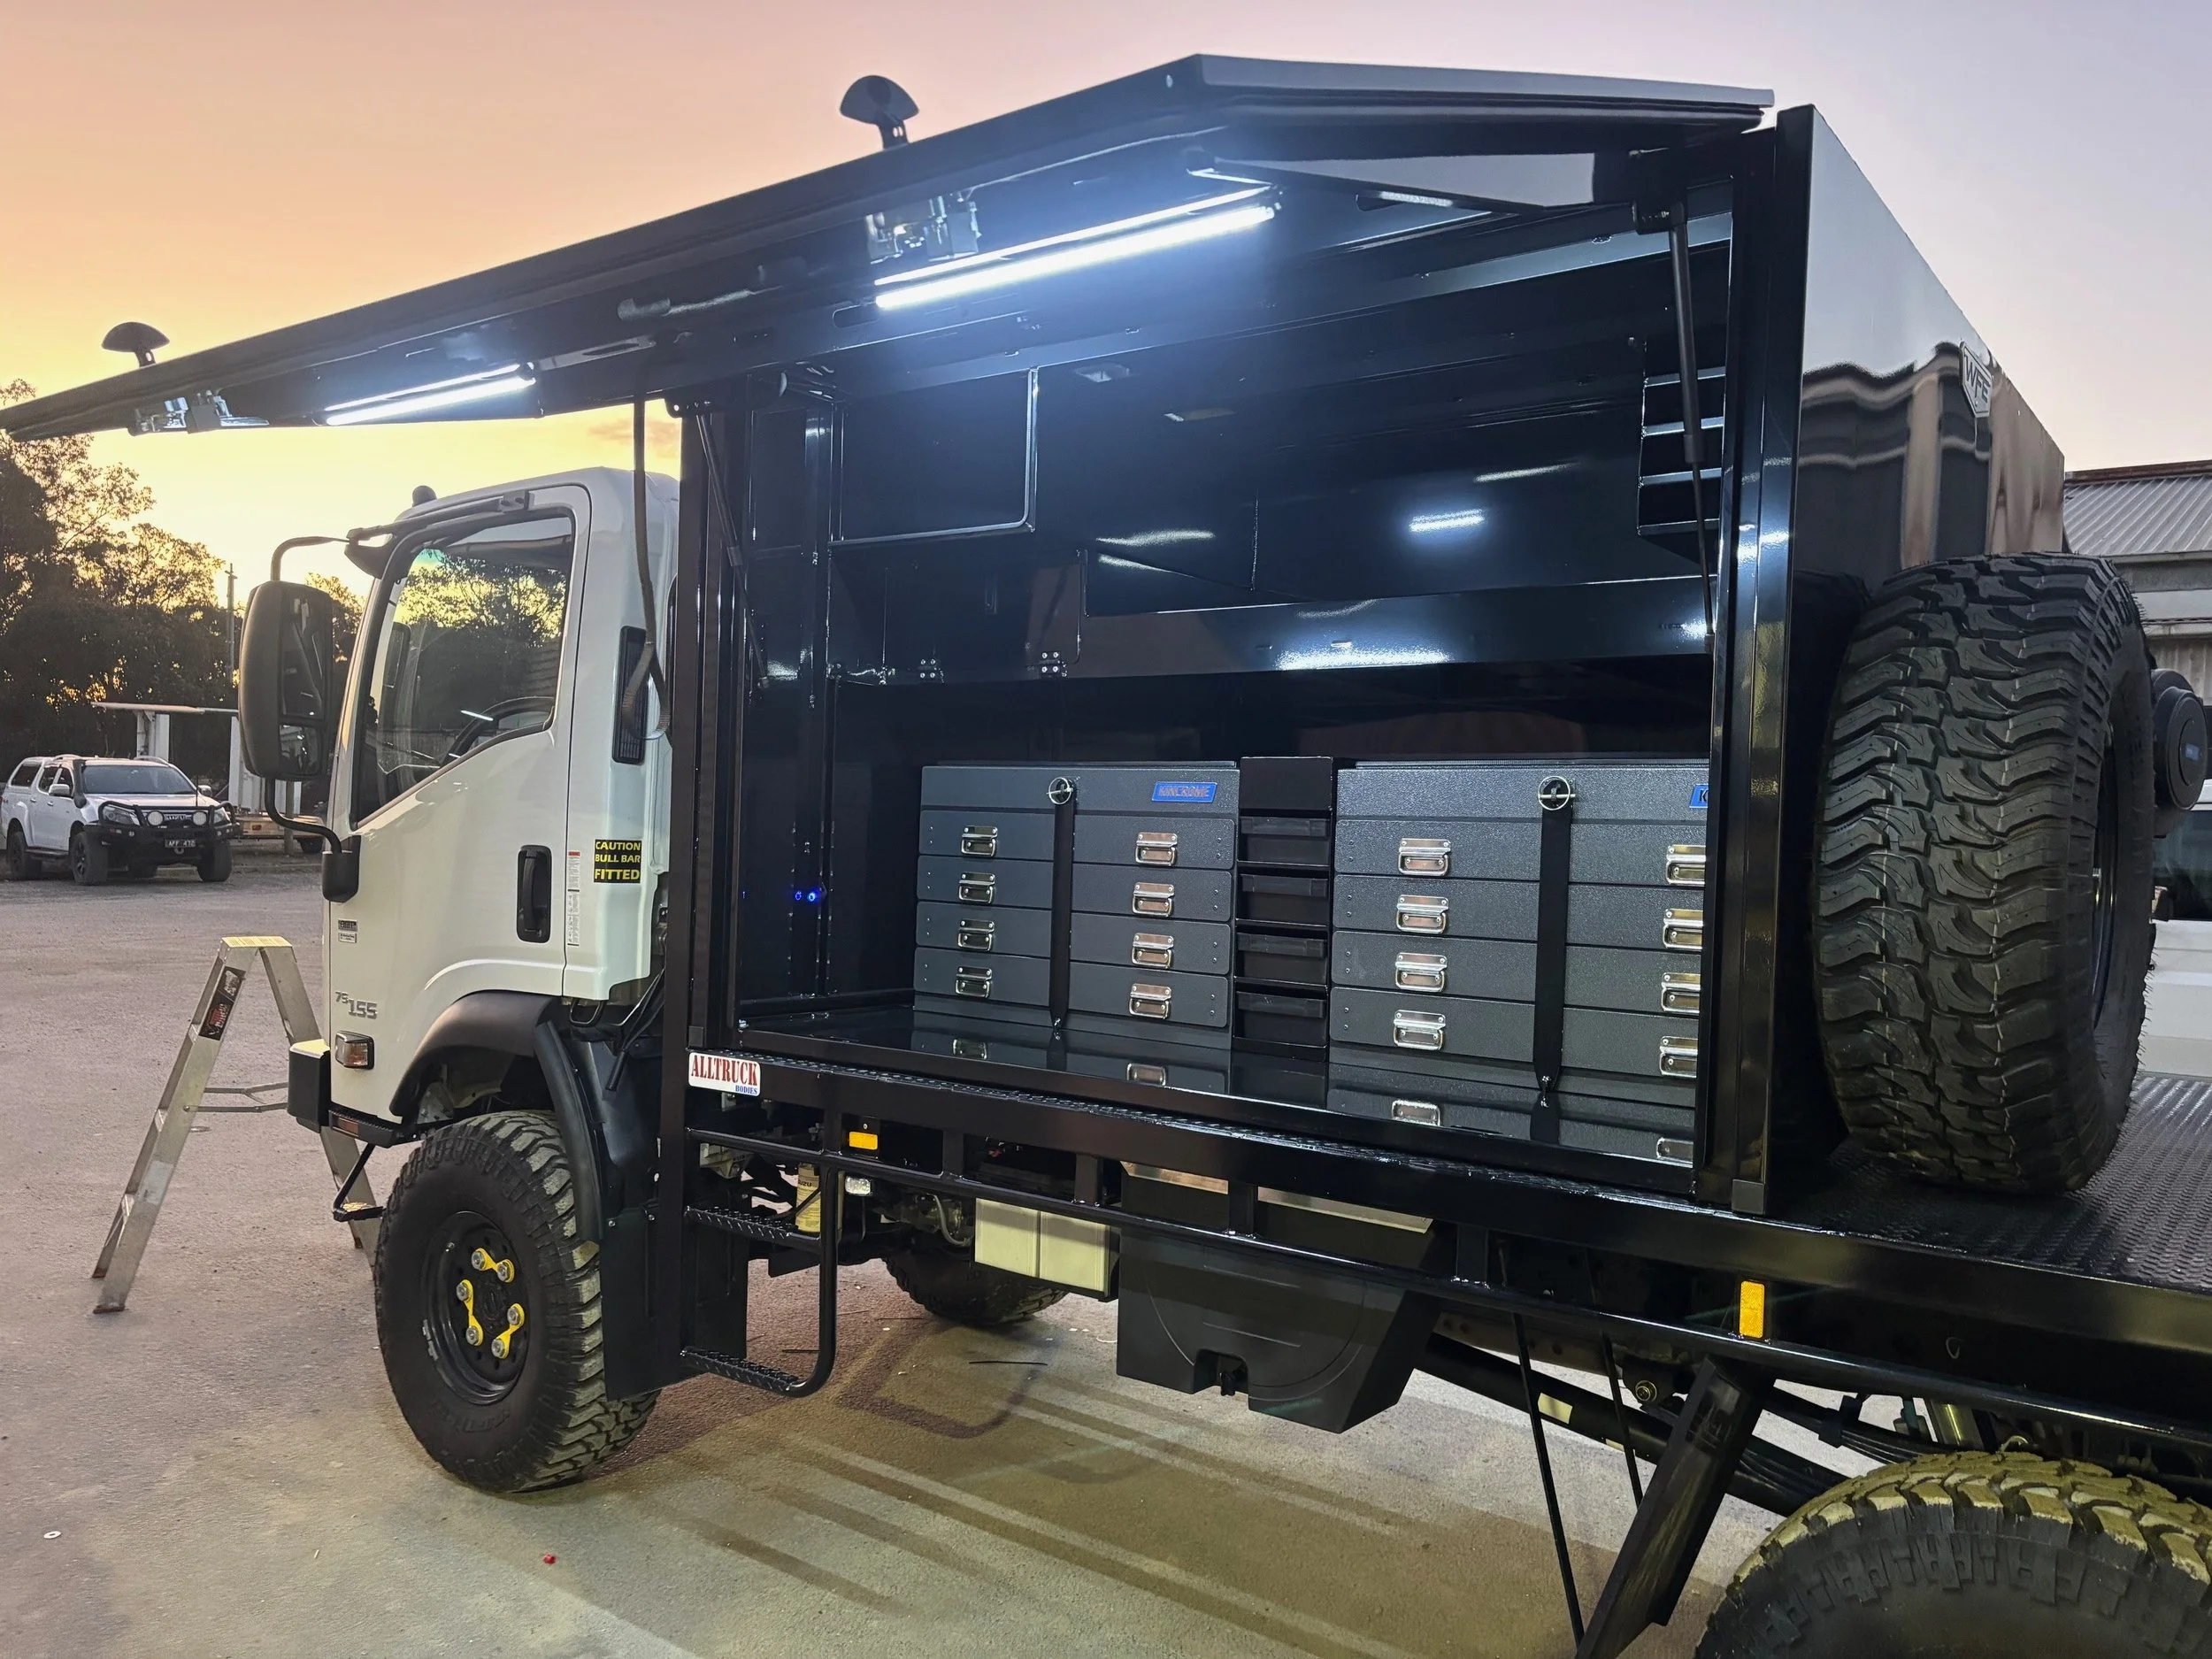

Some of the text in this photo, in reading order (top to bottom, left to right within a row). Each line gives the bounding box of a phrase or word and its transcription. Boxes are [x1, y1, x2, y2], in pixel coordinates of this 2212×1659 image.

[1963, 355, 1991, 404] WFE
[595, 841, 641, 851] CAUTION
[595, 854, 641, 864] BULL BAR
[594, 869, 640, 880] FITTED
[335, 991, 378, 1019] 75 155
[691, 1054, 757, 1087] ALLTRUCK
[735, 1085, 758, 1095] BODIES
